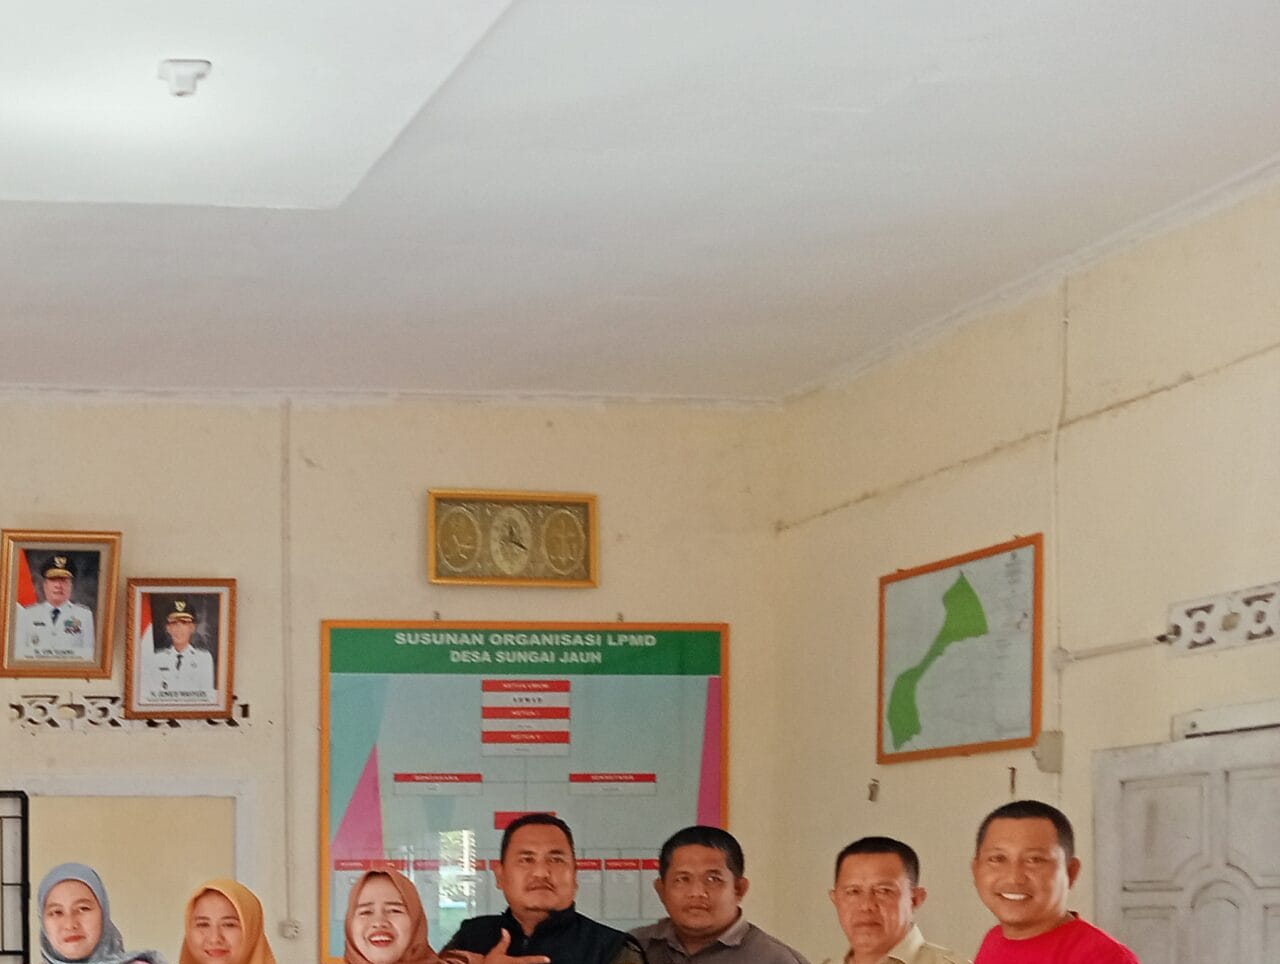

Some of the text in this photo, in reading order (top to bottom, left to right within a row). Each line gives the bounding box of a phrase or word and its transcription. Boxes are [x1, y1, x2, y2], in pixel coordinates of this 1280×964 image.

[394, 632, 657, 647] SUSUNAN ORGANISASI LPMD
[449, 650, 492, 663] DESA
[495, 650, 556, 663] SUNGAI
